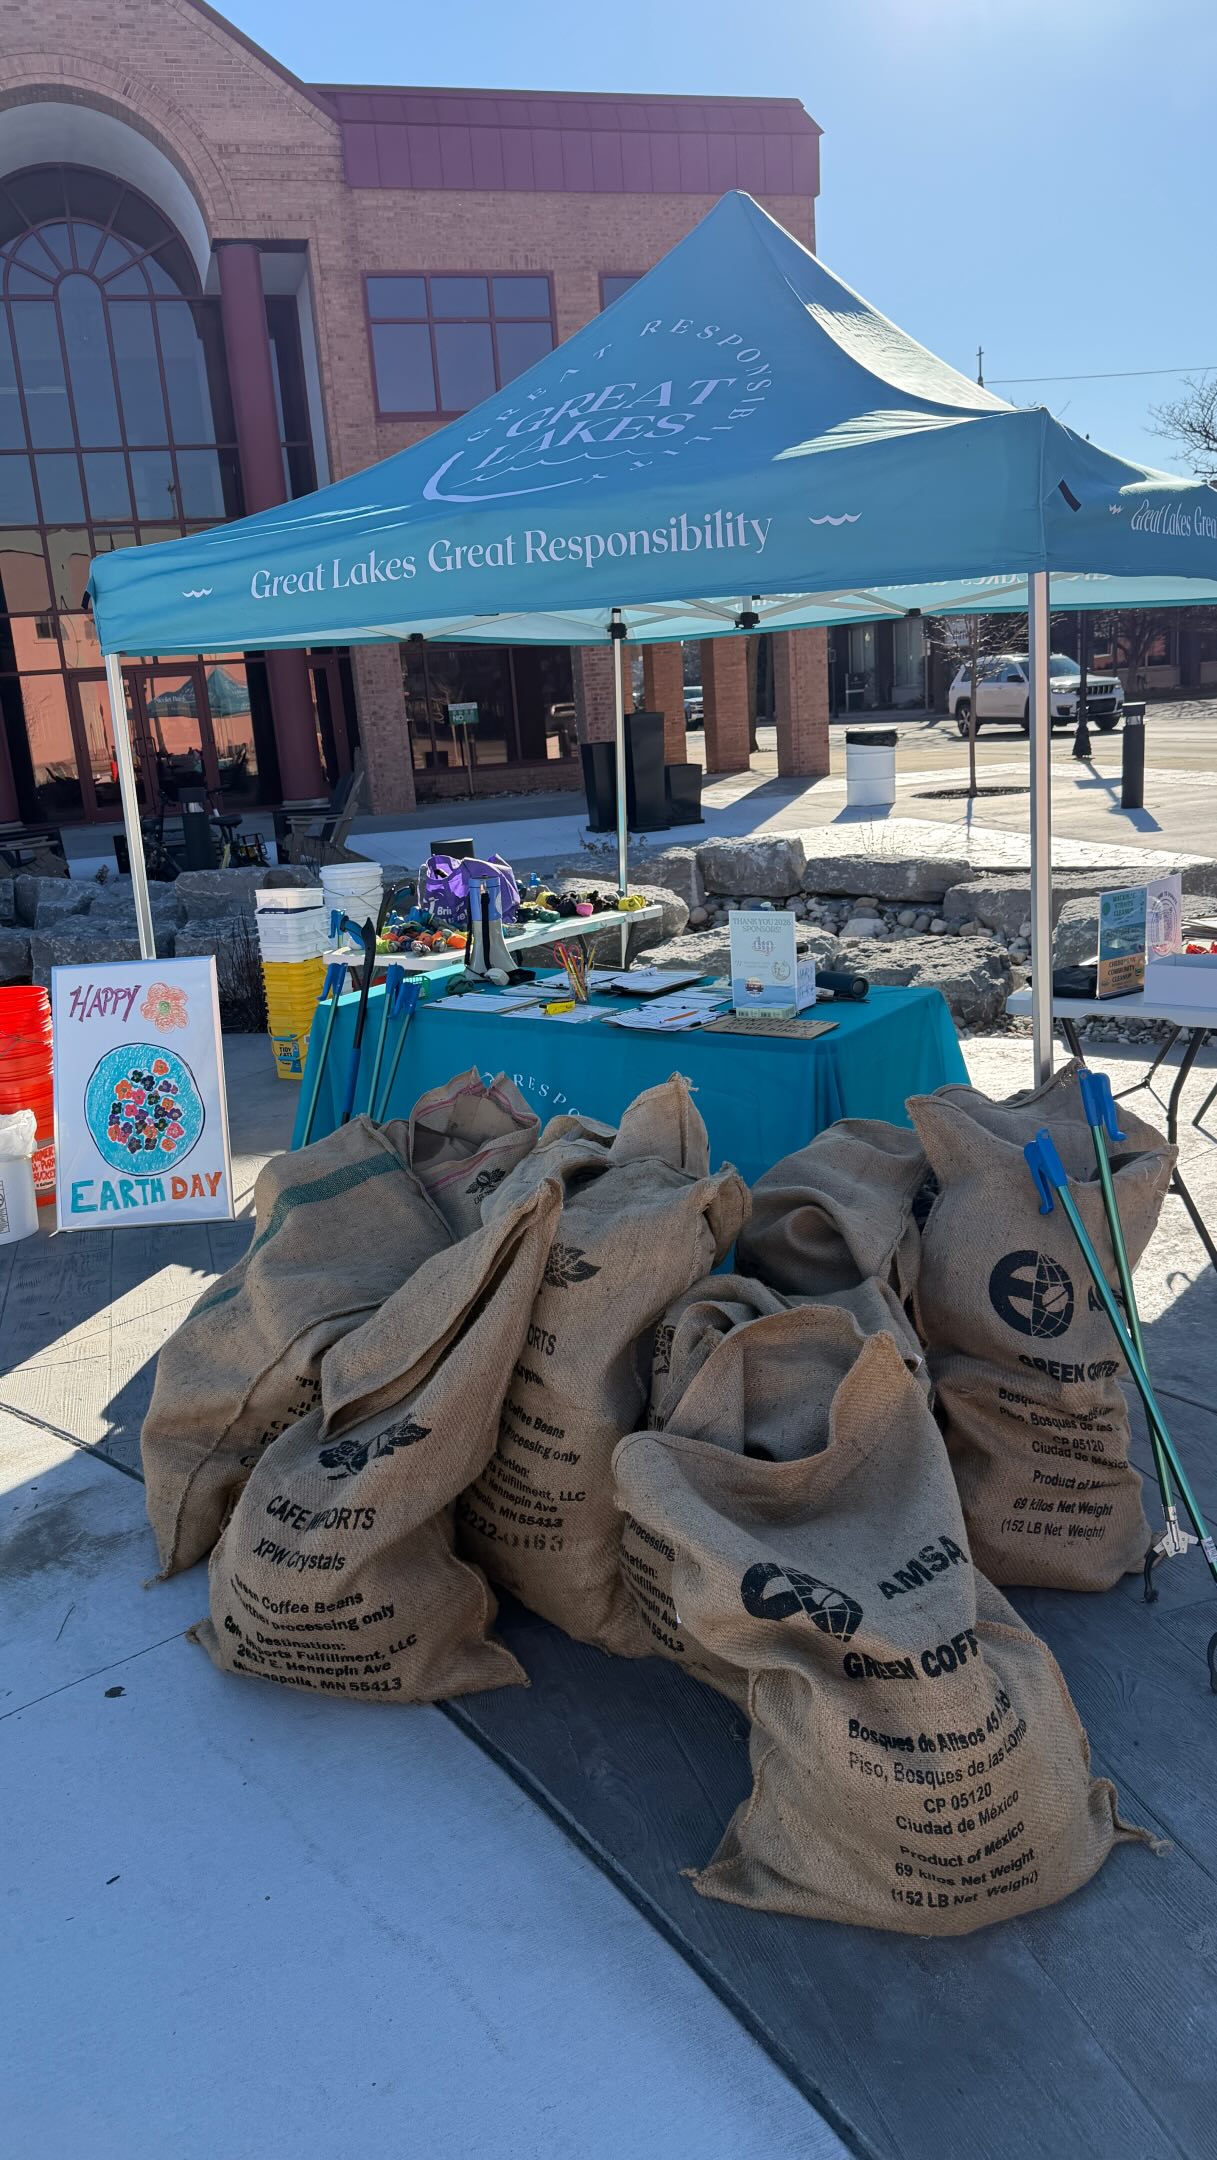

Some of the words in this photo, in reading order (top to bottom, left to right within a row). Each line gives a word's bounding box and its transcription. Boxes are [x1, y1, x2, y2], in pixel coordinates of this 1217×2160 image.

[507, 377, 737, 438] GREAT
[471, 412, 697, 471] LAKES
[1131, 498, 1168, 532] Great
[1162, 501, 1191, 537] Lakes
[251, 561, 326, 600] Great
[333, 549, 417, 590] Lakes
[428, 534, 517, 574] Great
[524, 508, 774, 569] Responsibility
[733, 917, 758, 926] THANK
[759, 917, 774, 926] YOU
[69, 983, 142, 1023] HAPPY
[70, 1177, 167, 1214] EARTH
[170, 1170, 223, 1200] DAY
[1018, 1353, 1086, 1384] GREEN
[533, 1417, 565, 1440] Beans
[1030, 1411, 1078, 1430] Bosques
[1079, 1421, 1094, 1432] de
[553, 1450, 581, 1466] only
[1031, 1440, 1072, 1459] Ciudad
[1074, 1451, 1089, 1462] de
[1072, 1437, 1105, 1453] 05120
[1032, 1469, 1077, 1490] Product
[533, 1500, 558, 1513] Ave
[559, 1490, 587, 1502] LLC
[1013, 1497, 1028, 1510] 69
[1028, 1498, 1055, 1513] kilos
[1056, 1500, 1075, 1514] Net
[1077, 1501, 1113, 1518] Weight
[266, 1495, 313, 1531] CAFE
[498, 1505, 517, 1521] MN
[628, 1519, 676, 1562] processing
[1001, 1518, 1025, 1535] (152
[1026, 1520, 1042, 1535] LB
[1044, 1522, 1063, 1537] Net
[1067, 1523, 1107, 1541] Weight)
[253, 1537, 291, 1565] XPW
[287, 1550, 346, 1573] Crystals
[876, 1534, 969, 1600] AMSA
[262, 1596, 310, 1615] Coffee
[314, 1592, 364, 1614] Beans
[271, 1617, 360, 1633] processing
[362, 1602, 395, 1625] only
[661, 1609, 678, 1631] Ave
[256, 1631, 347, 1651] Destination:
[298, 1648, 386, 1663] Fulfillment,
[388, 1633, 418, 1655] LLC
[285, 1661, 359, 1678] Hennepin
[363, 1660, 392, 1675] Ave
[843, 1651, 919, 1680] GREEN
[320, 1679, 346, 1691] MN
[350, 1676, 402, 1692] 55413
[848, 1717, 916, 1753] Bosques
[917, 1731, 937, 1753] de
[936, 1726, 987, 1753] Alisos
[985, 1710, 1000, 1735] 45
[849, 1750, 889, 1783] Piso,
[893, 1760, 964, 1791] Bosques
[966, 1758, 987, 1778] de
[986, 1750, 1005, 1769] las
[895, 1815, 953, 1836] Ciudad
[957, 1817, 976, 1834] de
[977, 1789, 1020, 1827] México
[923, 1797, 946, 1814] CP
[951, 1781, 992, 1811] 05120
[899, 1844, 964, 1868] Product
[966, 1848, 982, 1865] of
[984, 1820, 1026, 1858] México
[895, 1862, 913, 1877] 69
[918, 1867, 956, 1887] kilos
[960, 1873, 988, 1887] Net
[989, 1848, 1035, 1880] Weight
[890, 1888, 924, 1908] (152
[927, 1891, 950, 1909] LB
[953, 1893, 979, 1906] Net
[986, 1870, 1039, 1898] Weight)
